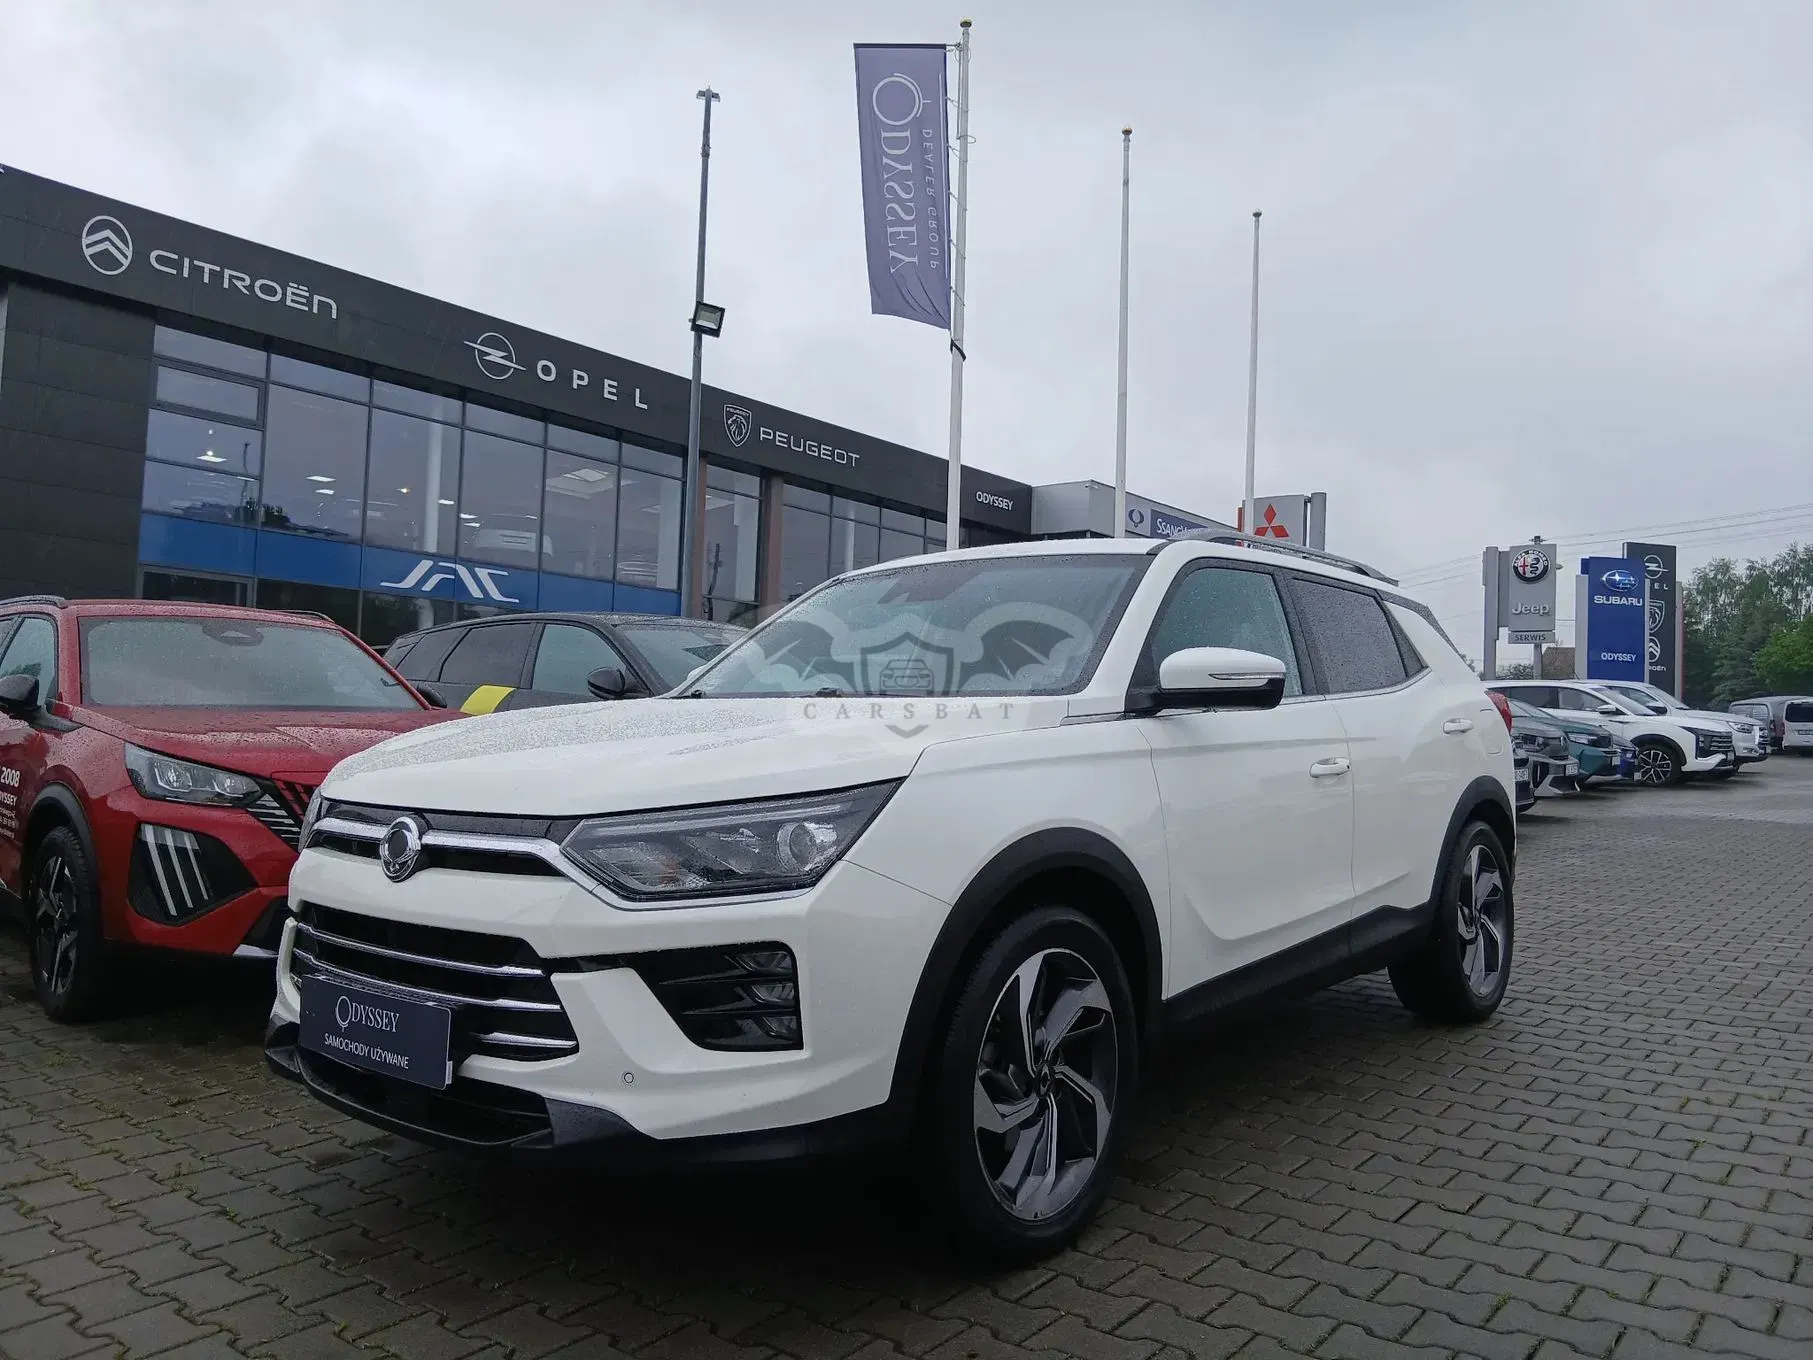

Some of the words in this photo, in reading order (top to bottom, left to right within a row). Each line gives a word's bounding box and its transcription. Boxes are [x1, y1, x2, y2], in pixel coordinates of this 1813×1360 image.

[536, 359, 648, 410] OPEL
[760, 427, 860, 467] PEUGEOT
[976, 491, 1014, 511] ODYSSEY
[380, 559, 520, 603] JAC
[1511, 602, 1550, 616] Jeep
[1593, 595, 1643, 606] SUBARU
[1515, 633, 1546, 641] SERWIS
[1601, 652, 1637, 662] ODYSSEY
[0, 766, 20, 788] 2008
[336, 995, 400, 1033] ODYSSEY
[324, 1032, 370, 1057] SAMOCHODY
[370, 1046, 410, 1070] UŻYWANE
